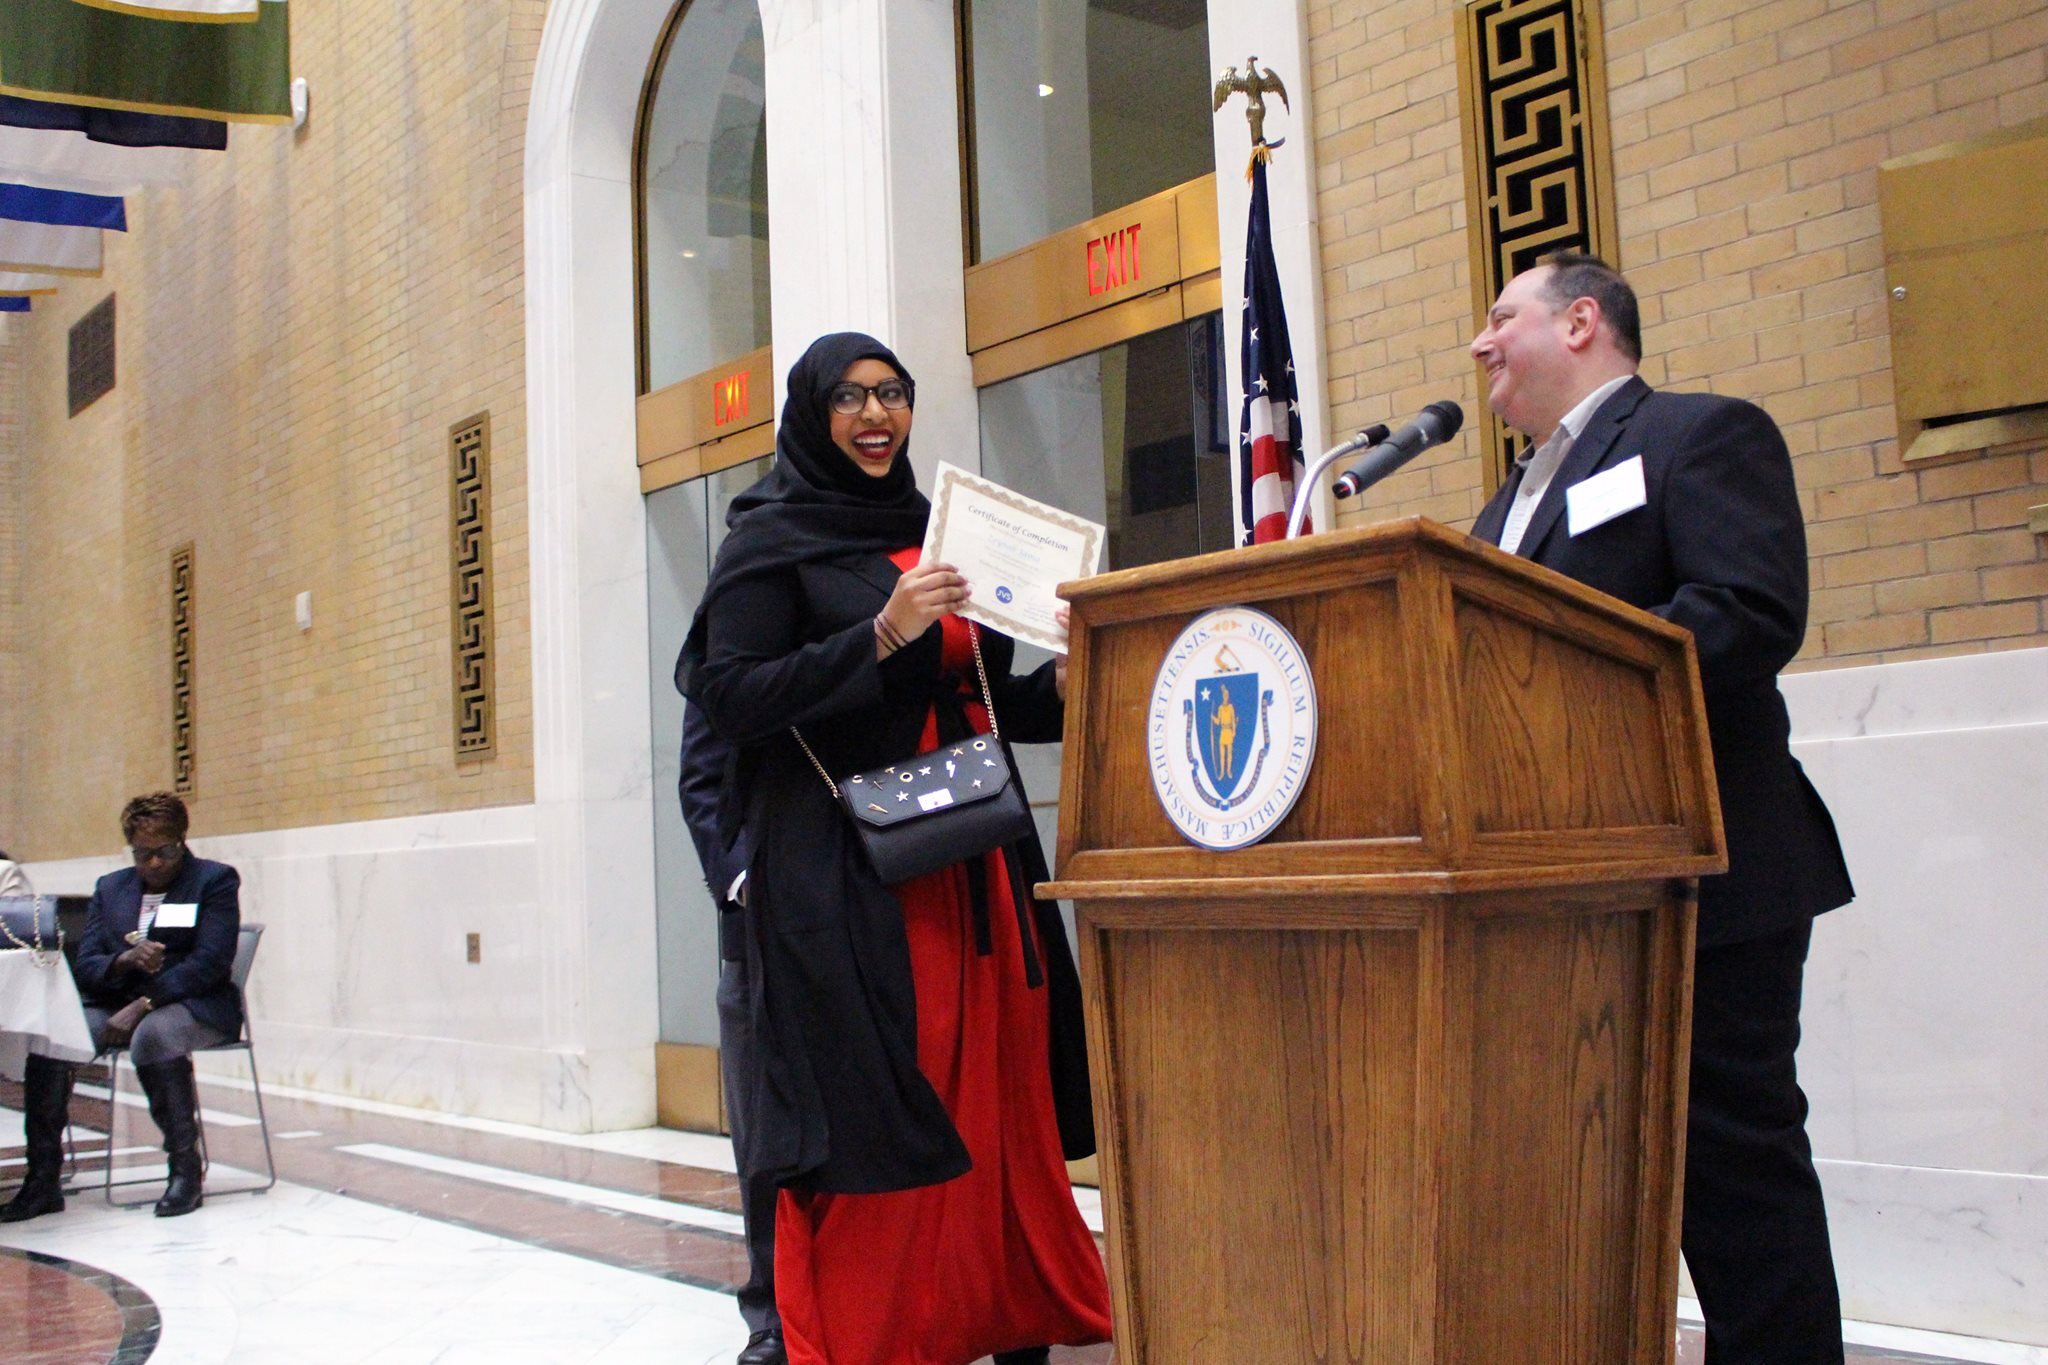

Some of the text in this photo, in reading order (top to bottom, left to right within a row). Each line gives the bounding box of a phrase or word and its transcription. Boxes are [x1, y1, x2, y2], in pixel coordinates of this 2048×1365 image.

[1087, 223, 1141, 296] EXIT
[714, 370, 750, 426] EXIT
[968, 504, 1010, 528] Certificate
[1012, 525, 1021, 535] of
[1022, 529, 1069, 552] Completion
[997, 589, 1011, 601] JVS
[1248, 622, 1307, 714] SIGILLUM
